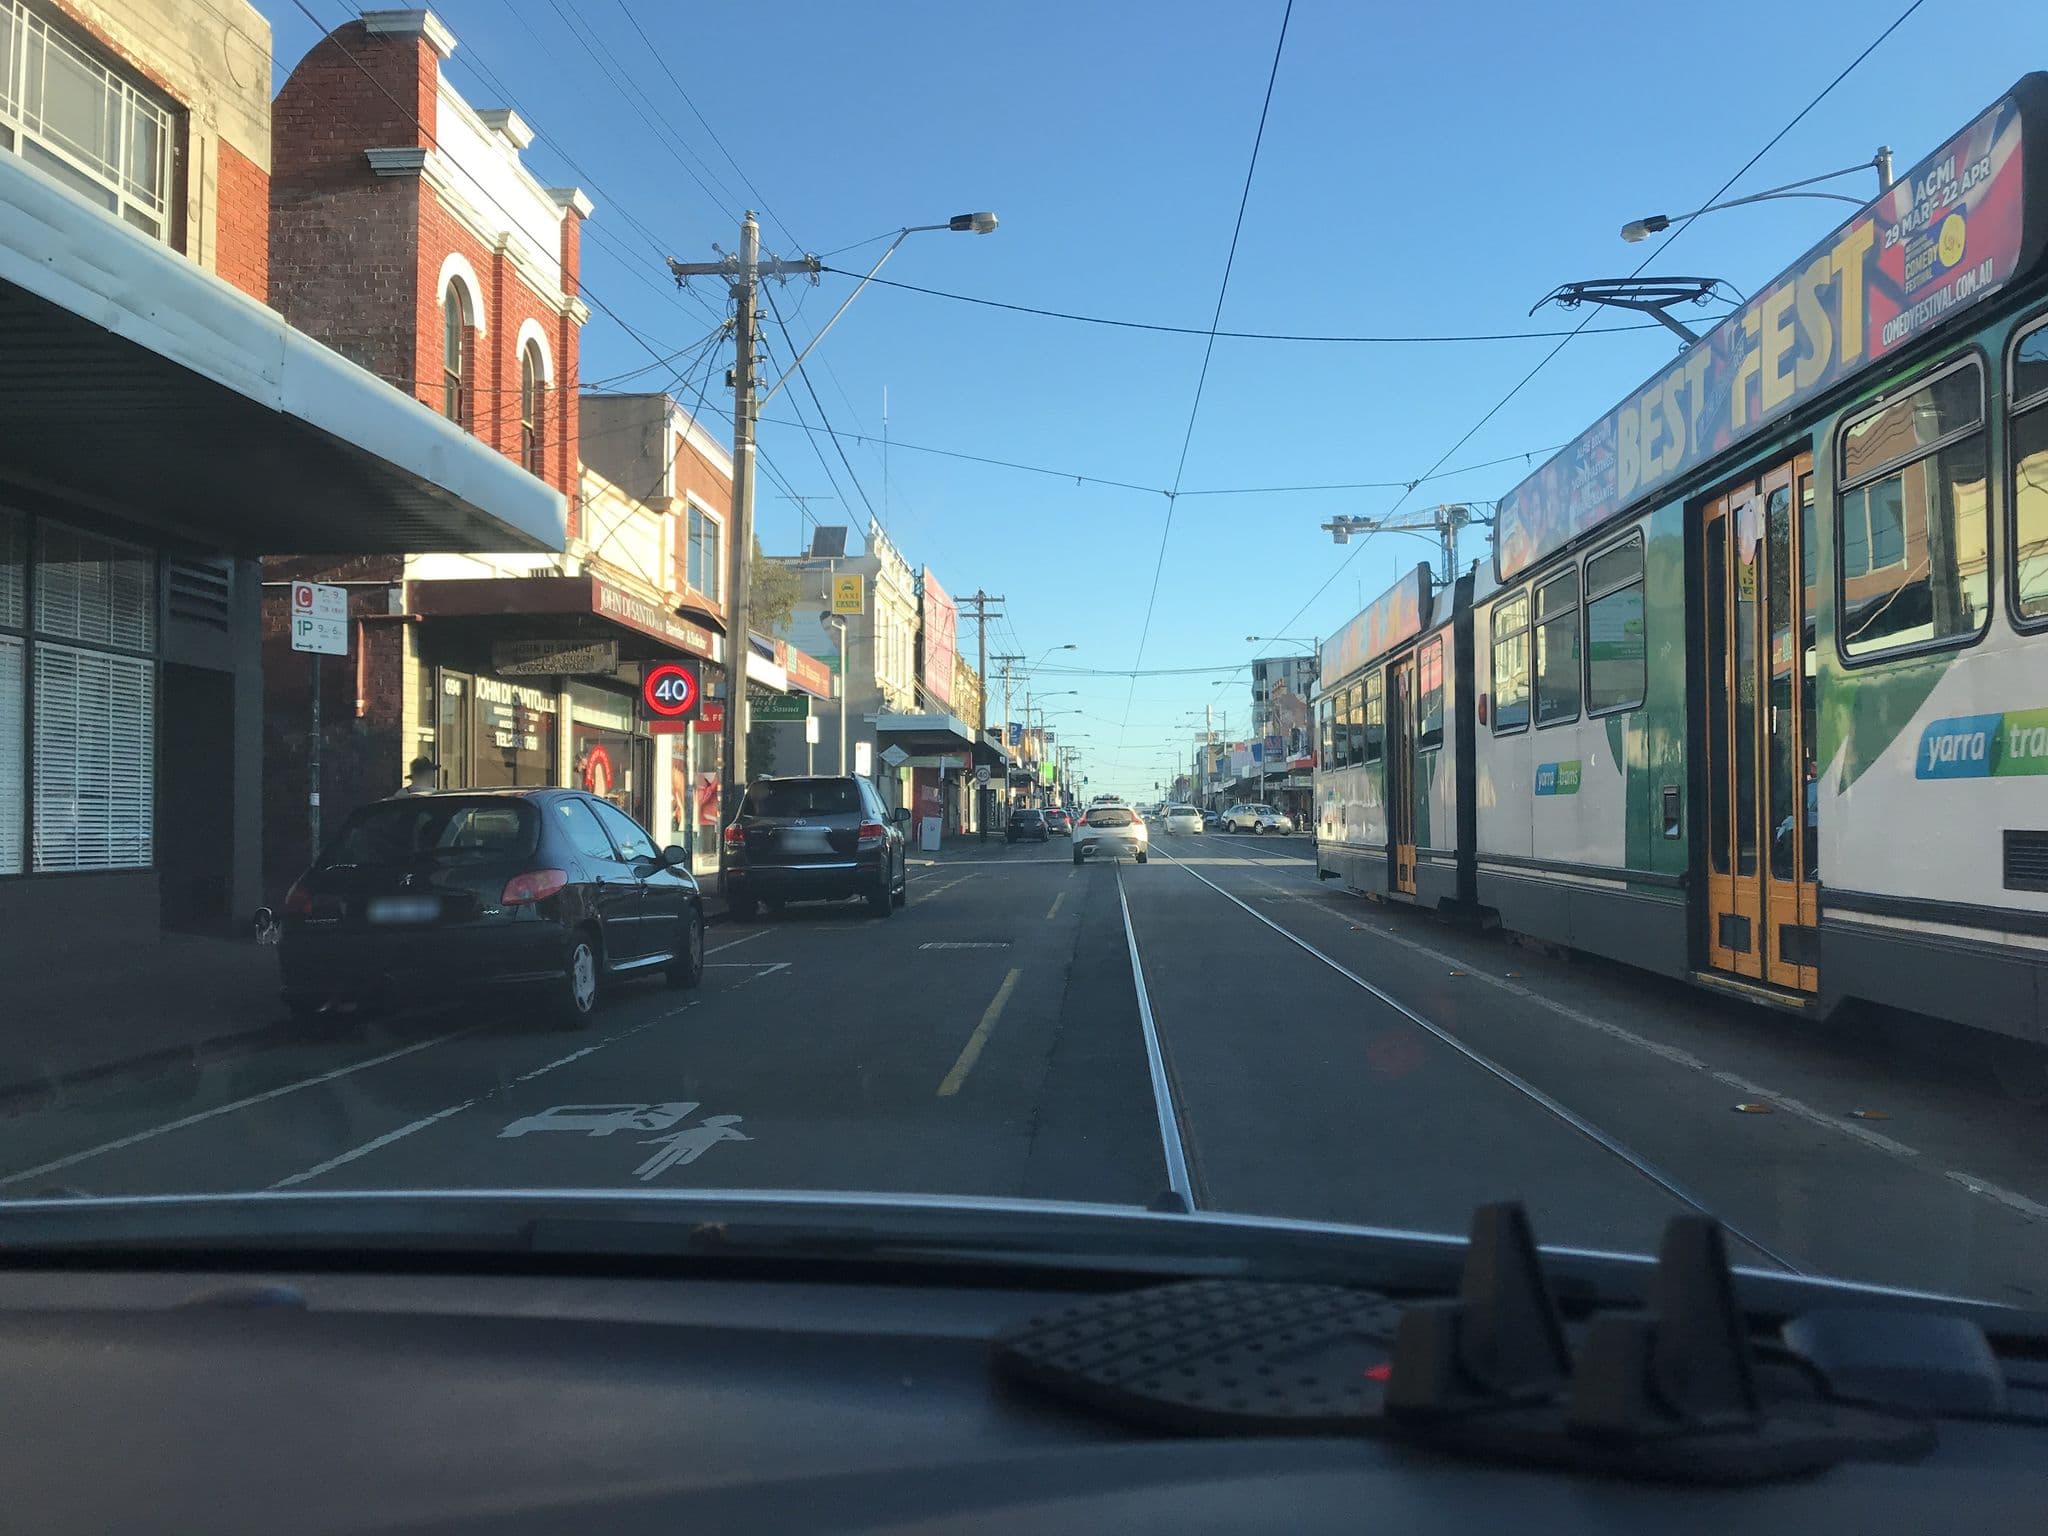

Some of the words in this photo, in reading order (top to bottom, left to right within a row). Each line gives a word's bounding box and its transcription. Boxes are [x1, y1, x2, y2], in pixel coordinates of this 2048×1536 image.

[1914, 155, 1956, 205] ACMI
[1885, 226, 1900, 249] 29
[1902, 203, 1931, 237] MAR
[1942, 184, 1959, 207] 22
[1960, 157, 1991, 193] APR
[1905, 243, 1939, 280] COMEDY
[1905, 267, 1934, 294] FESTIVAL
[1882, 258, 1994, 347] COMEDYFESTIVAL.COM.AU
[1617, 346, 1712, 500] BEST
[1731, 219, 1875, 431] FEST
[299, 587, 310, 606] C
[600, 586, 621, 614] JOHN
[631, 601, 655, 628] SANTO
[297, 620, 313, 636] 1P
[445, 678, 460, 697] 694
[476, 677, 501, 703] JOHN
[501, 683, 512, 704] DI
[655, 679, 688, 701] 40
[772, 705, 800, 713] Sauna
[1010, 725, 1018, 734] P
[1928, 731, 1985, 771] yarra
[1538, 771, 1554, 791] yarra
[1558, 768, 1578, 786] trams
